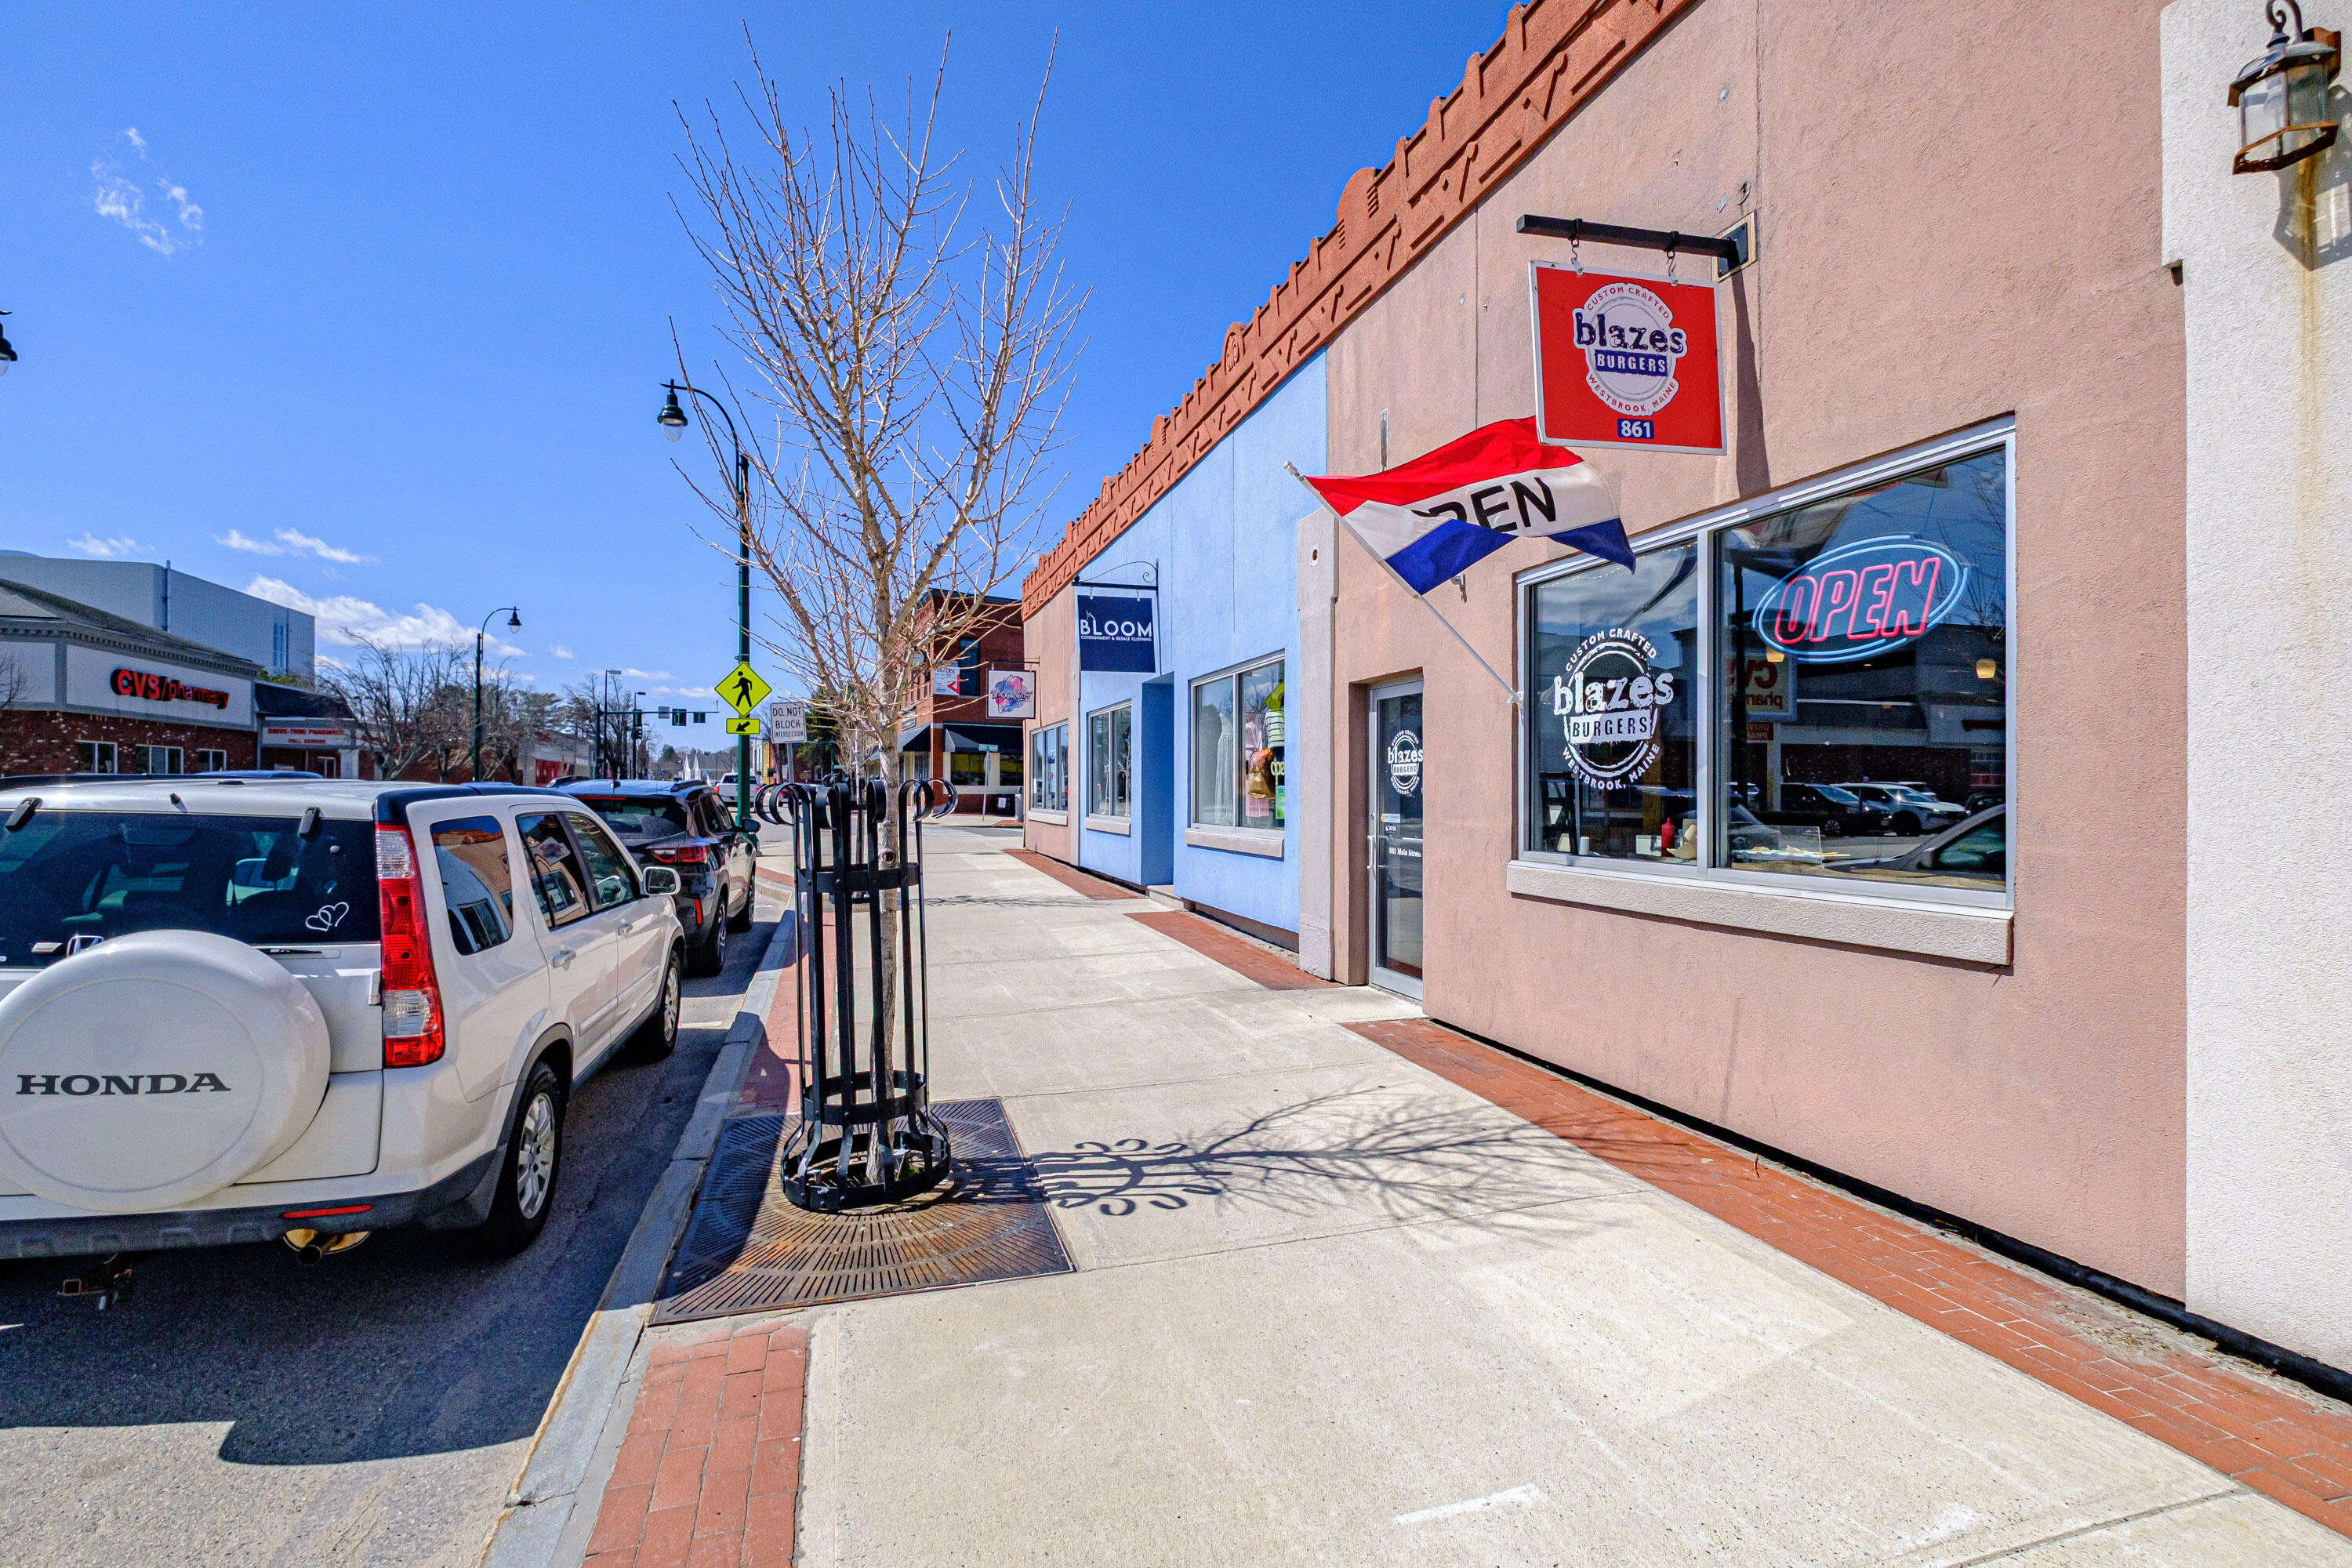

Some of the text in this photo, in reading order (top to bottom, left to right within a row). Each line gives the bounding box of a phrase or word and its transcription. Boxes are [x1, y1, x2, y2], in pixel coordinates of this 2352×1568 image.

[1587, 286, 1669, 319] CUSTOM CRAFTED
[1575, 312, 1684, 354] blazes
[1597, 354, 1666, 373] BURGERS
[1588, 374, 1675, 412] WESTBROOK, MAINE
[1621, 420, 1651, 438] 861
[1410, 477, 1556, 533] EN
[1774, 557, 1941, 644] OPEN
[1080, 617, 1152, 637] BLOOM
[1566, 628, 1657, 672] CUSTOM CRAFTED
[1553, 671, 1674, 715] blazes
[772, 707, 802, 717] DO NOT
[775, 720, 800, 729] BLOCK
[1573, 717, 1647, 737] BURGERS
[1387, 746, 1423, 764] blazes
[1563, 744, 1661, 791] WESTBROOK, MAINE
[16, 1073, 231, 1096] HONDA
